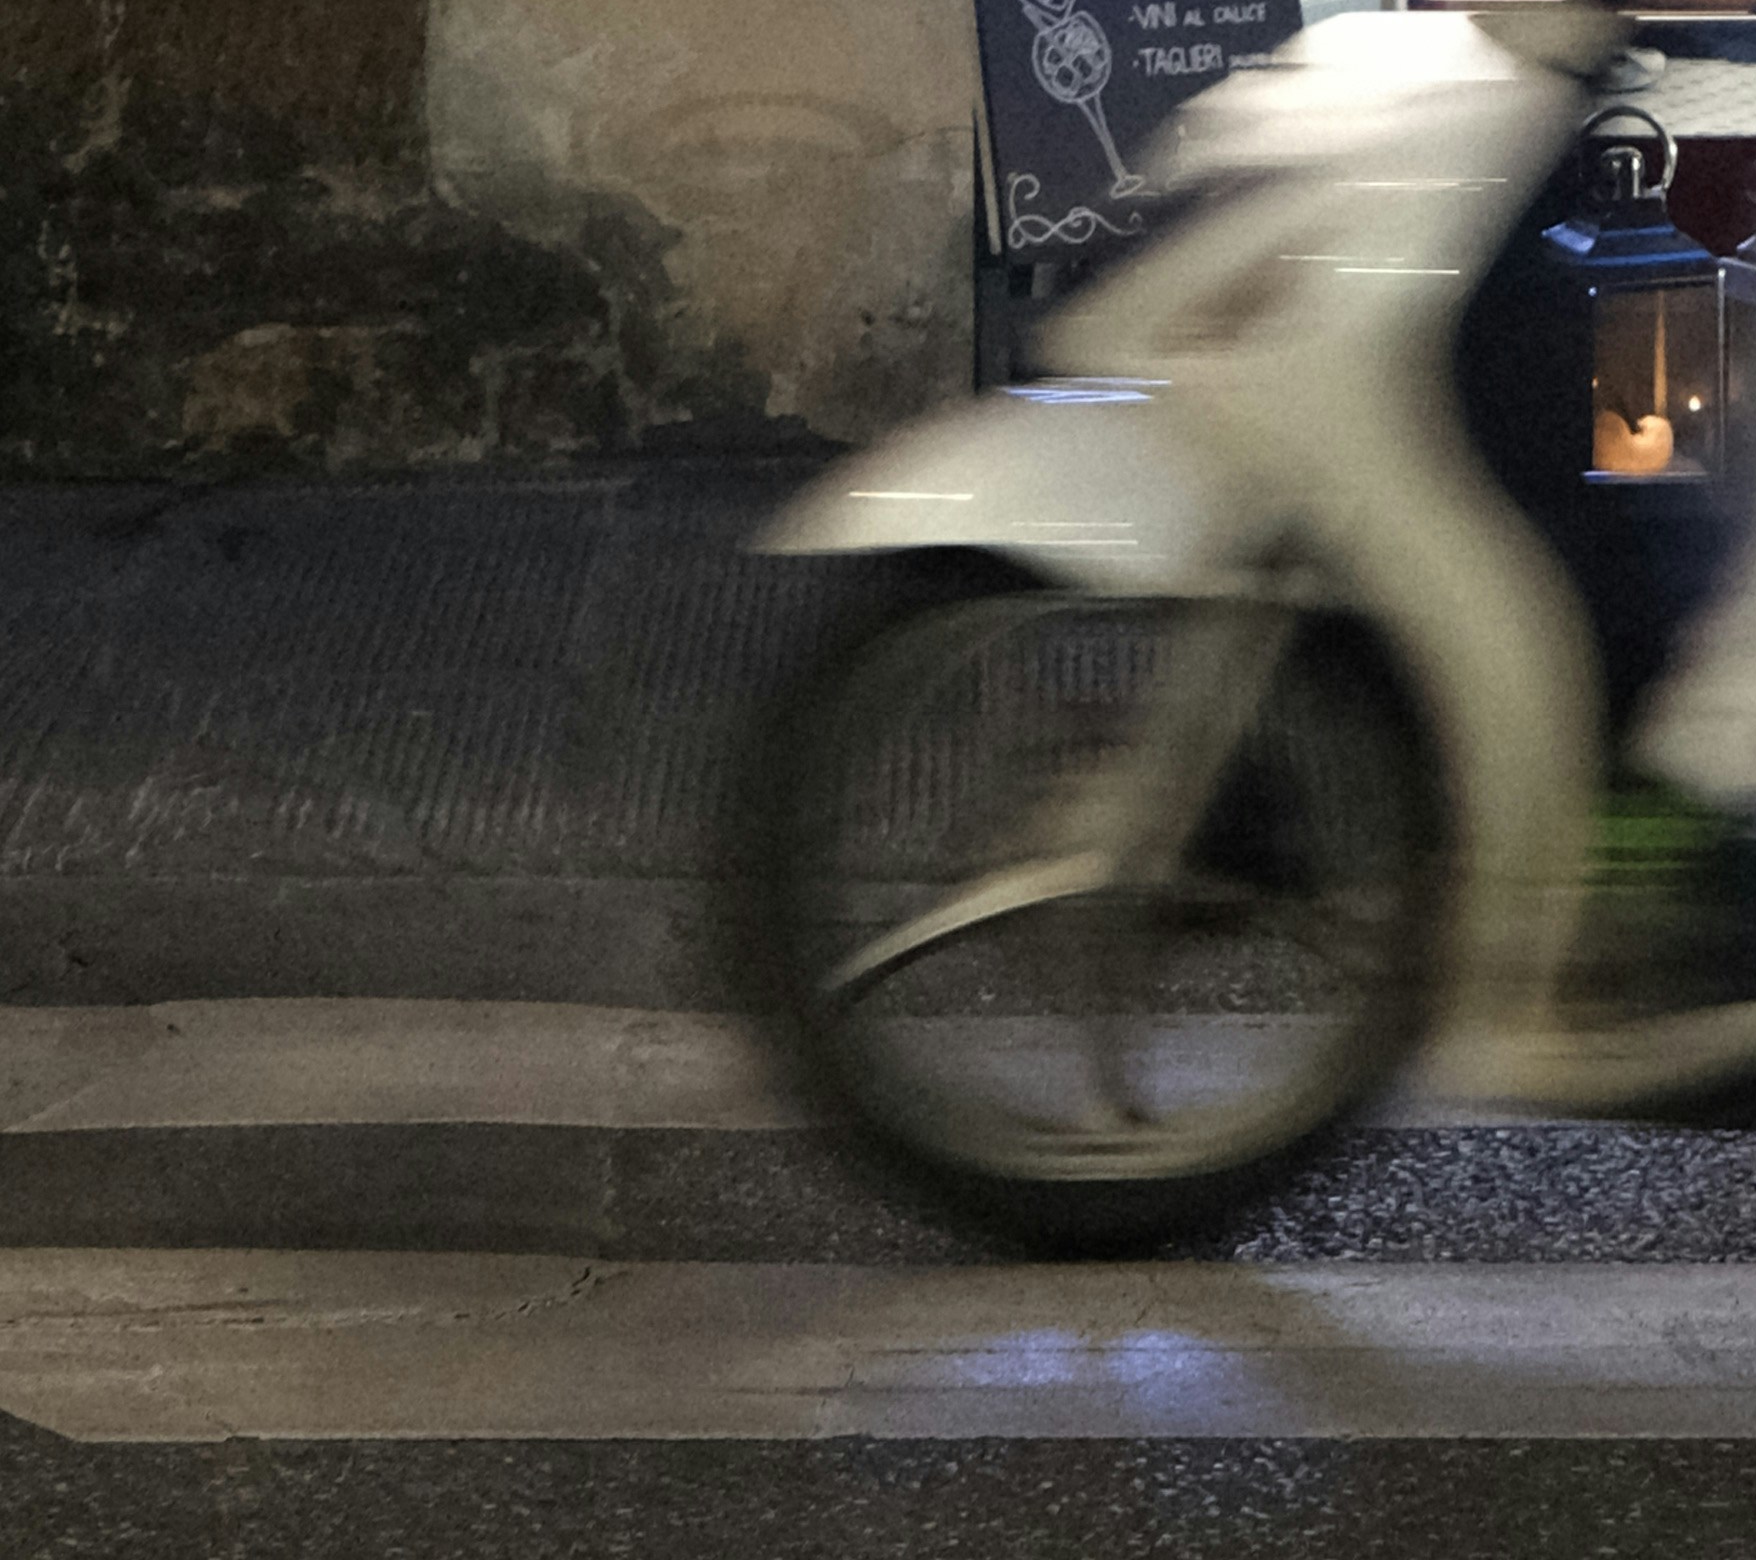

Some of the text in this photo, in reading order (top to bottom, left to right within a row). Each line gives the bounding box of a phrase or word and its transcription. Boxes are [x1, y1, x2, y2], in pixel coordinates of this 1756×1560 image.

[1133, 1, 1267, 30] VINI AL CALICE
[1137, 42, 1224, 76] TAGLIERI
